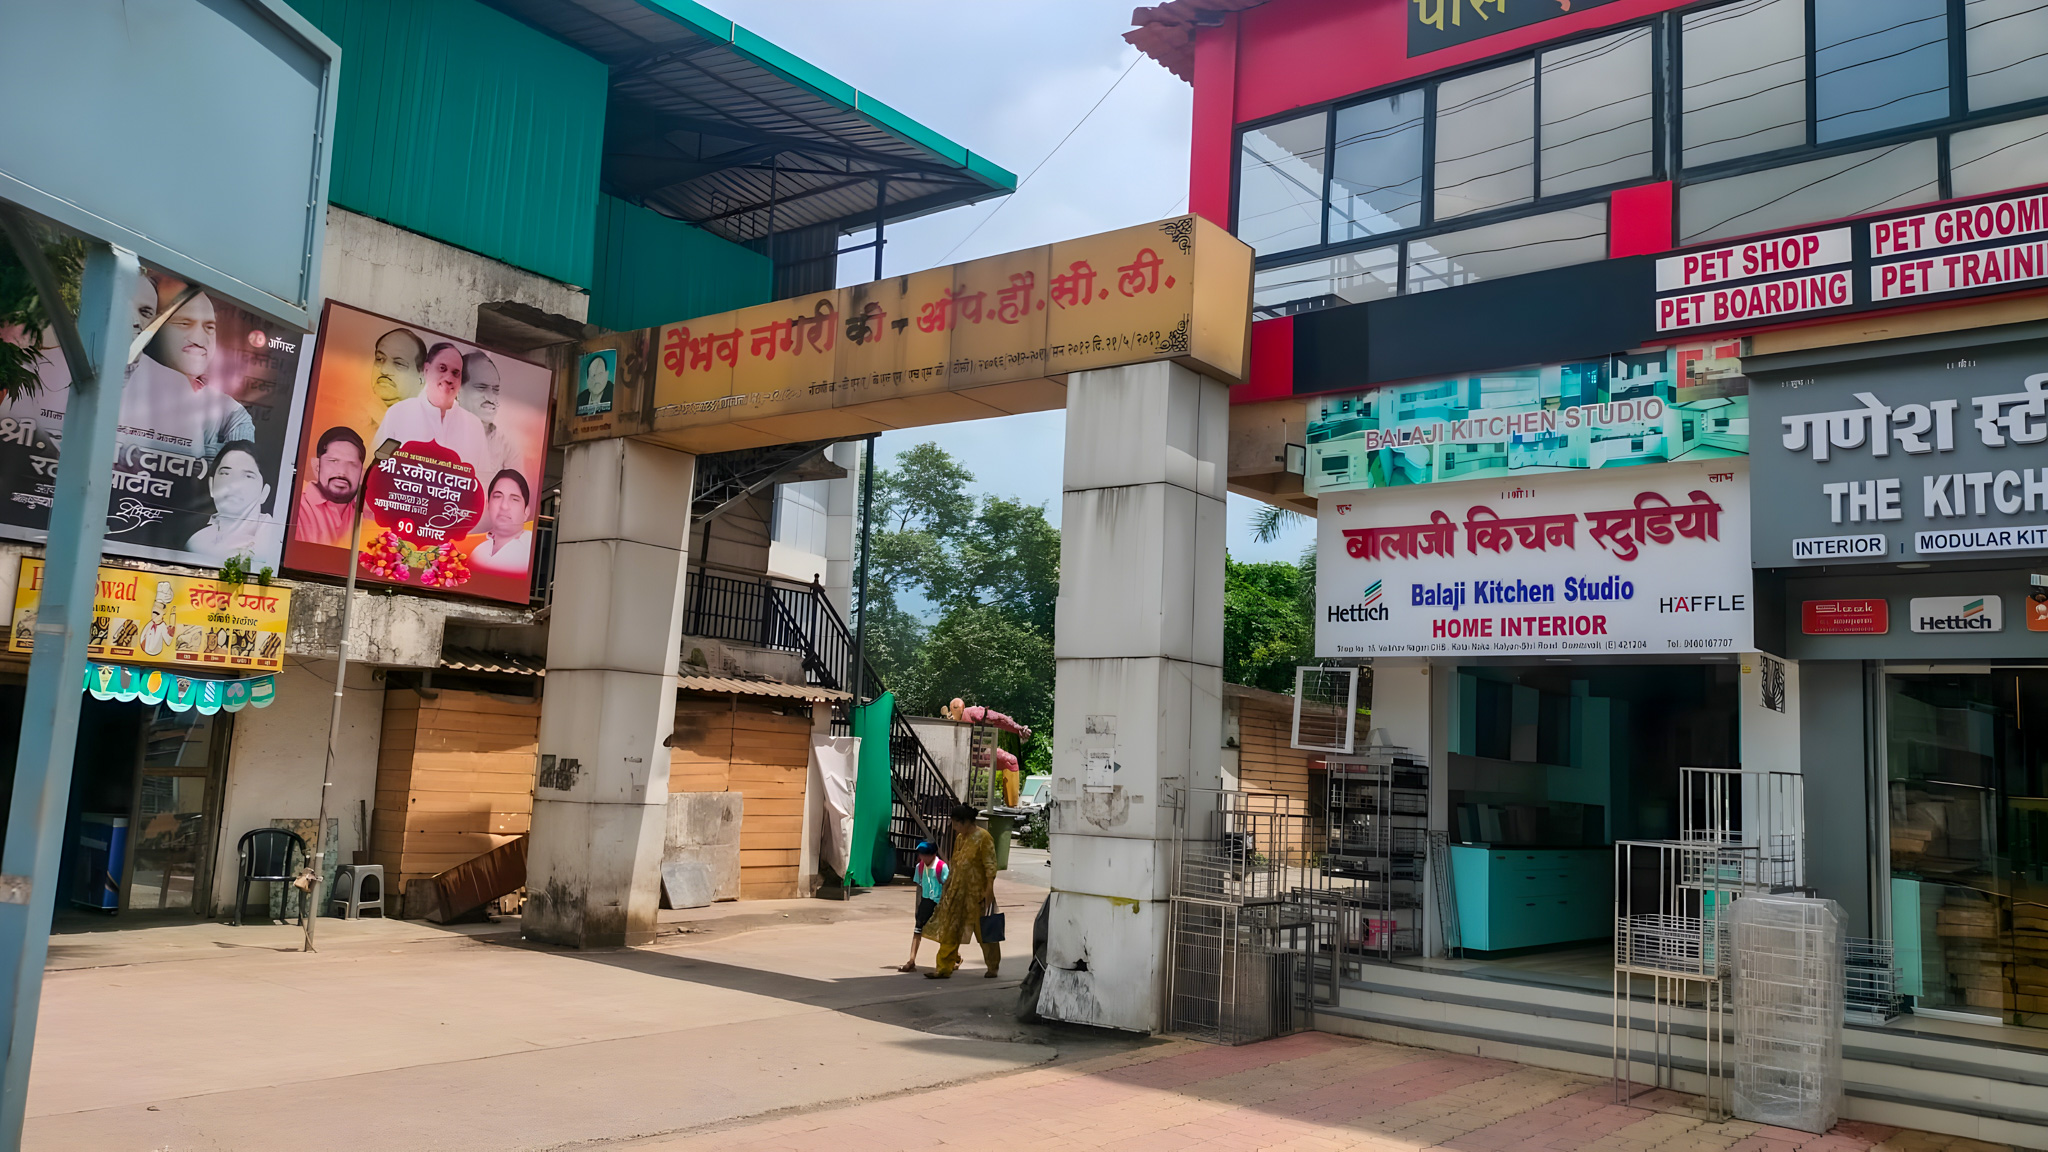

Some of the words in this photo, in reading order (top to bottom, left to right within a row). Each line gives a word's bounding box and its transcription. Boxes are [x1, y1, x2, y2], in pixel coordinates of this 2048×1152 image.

[1875, 217, 1926, 255] PET
[1684, 249, 1733, 285] PET
[1742, 236, 1820, 275] SHOP
[1881, 260, 1933, 298] PET
[1943, 243, 2048, 288] TRAINI
[1660, 294, 1705, 329] PET
[1713, 273, 1847, 321] BOARDING
[1366, 423, 1443, 450] BALAJI
[1451, 410, 1556, 441] KITCHEN
[1565, 399, 1664, 429] STUDIO
[1781, 391, 1958, 462] गणेश
[427, 484, 461, 502] पाटील
[1823, 478, 1903, 524] THE
[1342, 510, 1458, 561] बालाजी
[1463, 505, 1579, 555] किचन
[1584, 490, 1722, 561] स्टुडियो
[1795, 537, 1882, 556] INTERIOR
[1920, 531, 2012, 550] MODULAR
[2017, 529, 2048, 545] KIT
[1328, 602, 1389, 624] Hettich
[1411, 581, 1465, 611] Balaji
[1474, 577, 1554, 606] Kitchen
[1564, 573, 1634, 602] Studio
[1432, 617, 1493, 639] HOME
[1500, 615, 1607, 638] INTERIOR
[1921, 614, 1991, 631] Hettich
